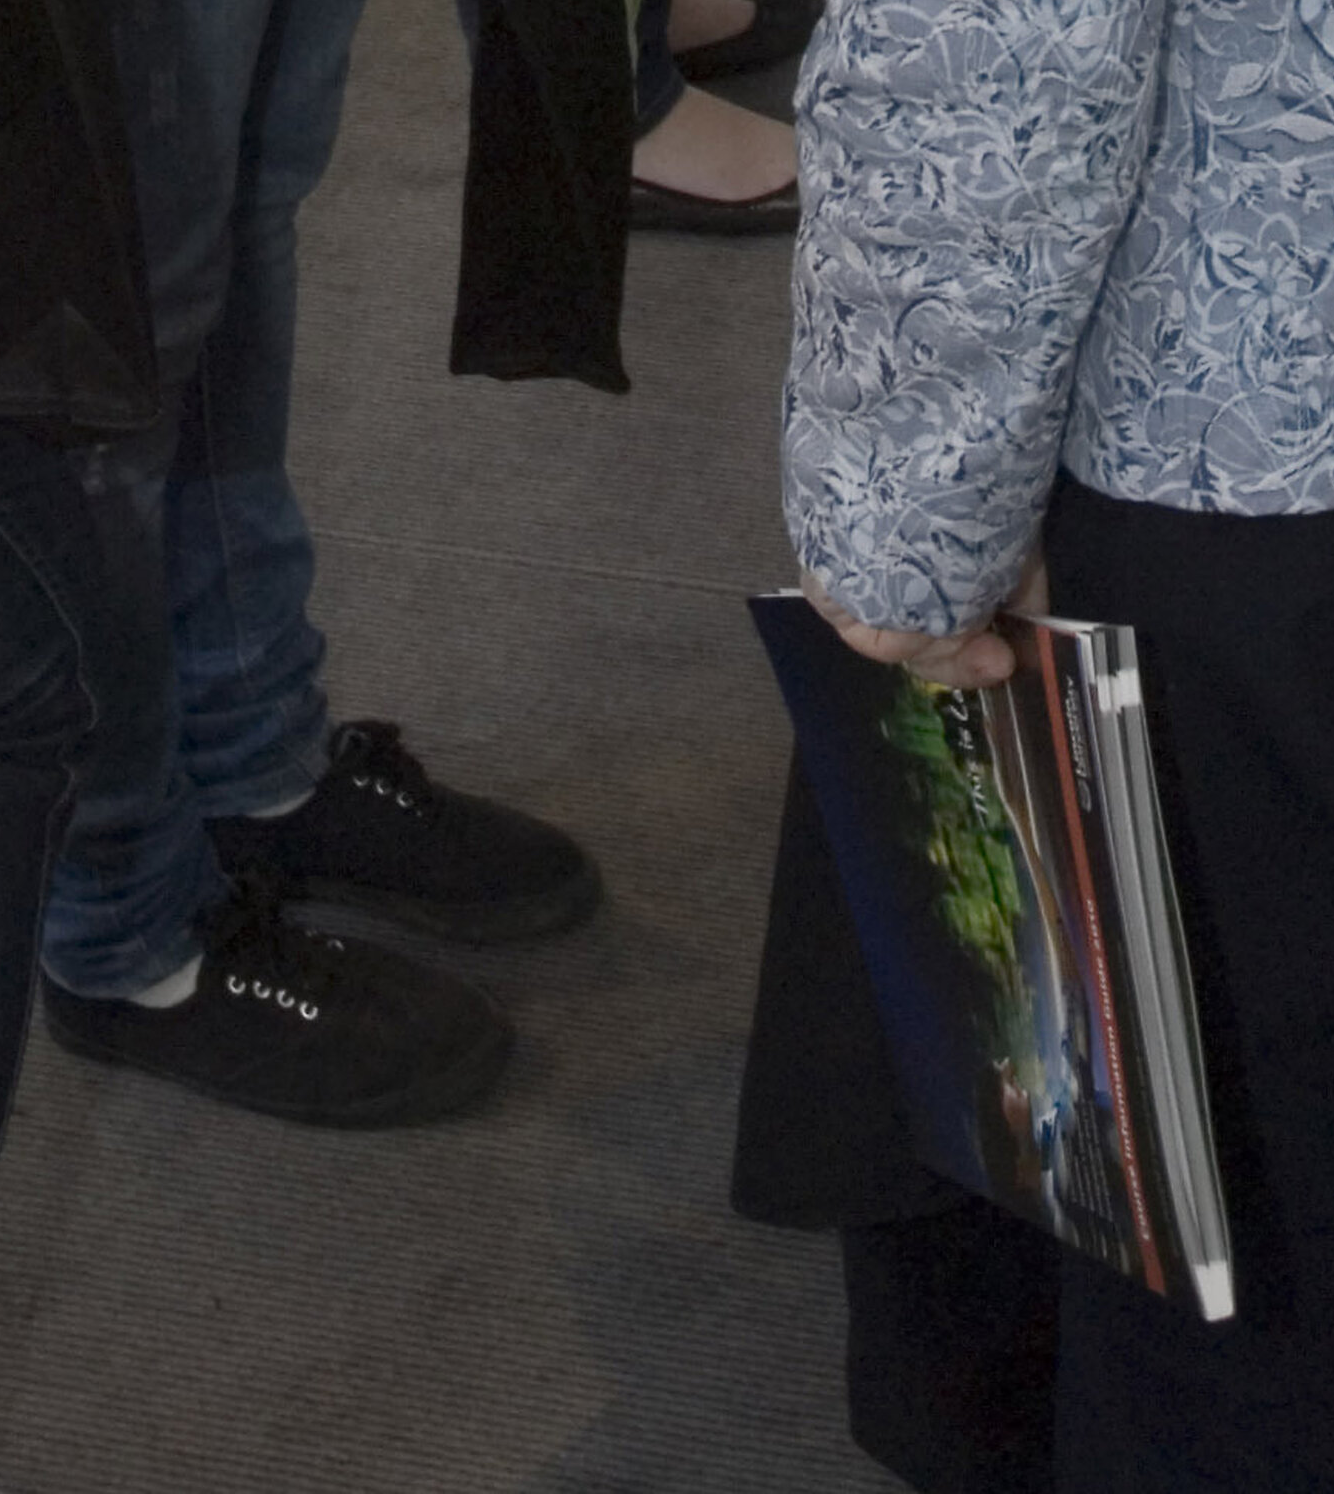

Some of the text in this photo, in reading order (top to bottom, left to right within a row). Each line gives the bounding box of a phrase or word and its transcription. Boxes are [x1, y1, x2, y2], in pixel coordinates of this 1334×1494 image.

[1096, 955, 1112, 1020] Guide
[1107, 1025, 1134, 1160] Information
[1128, 1164, 1151, 1242] Course
